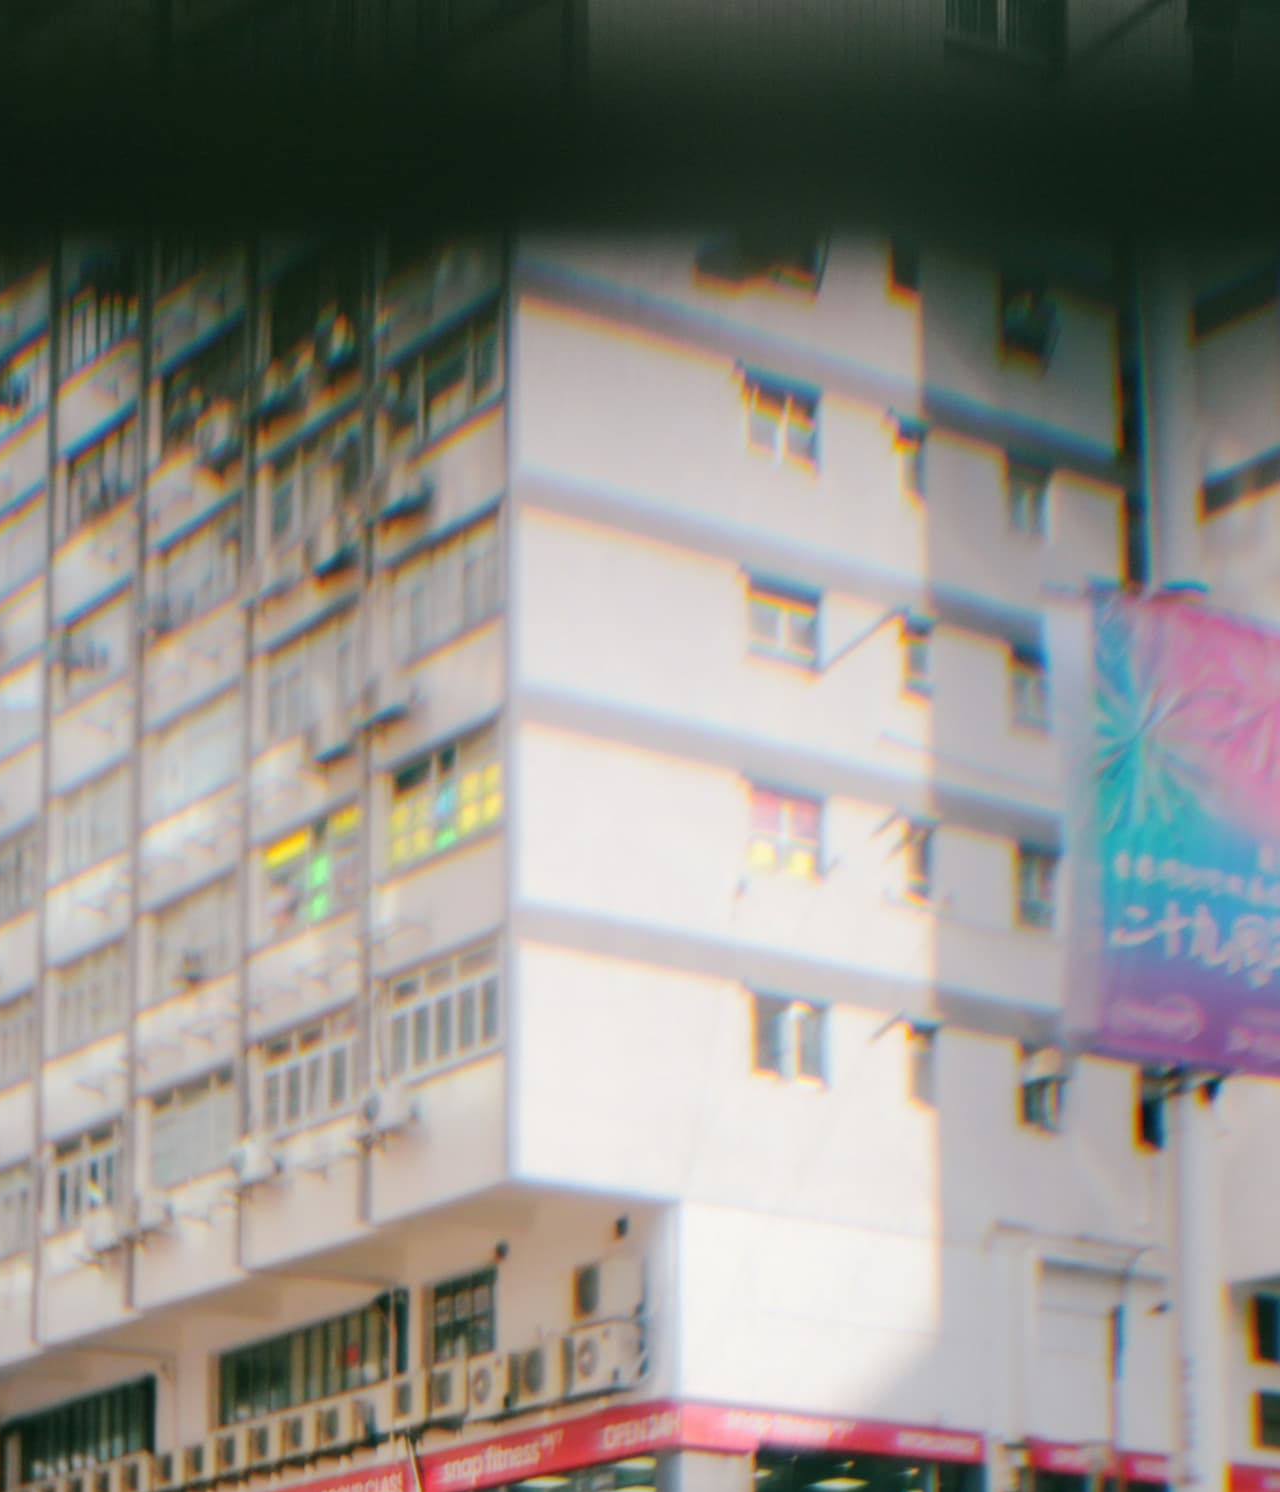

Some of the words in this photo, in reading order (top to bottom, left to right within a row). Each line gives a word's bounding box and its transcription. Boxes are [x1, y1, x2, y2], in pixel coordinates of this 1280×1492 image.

[603, 1416, 648, 1448] OPEN
[445, 1456, 483, 1485] snap
[485, 1443, 541, 1476] fitness
